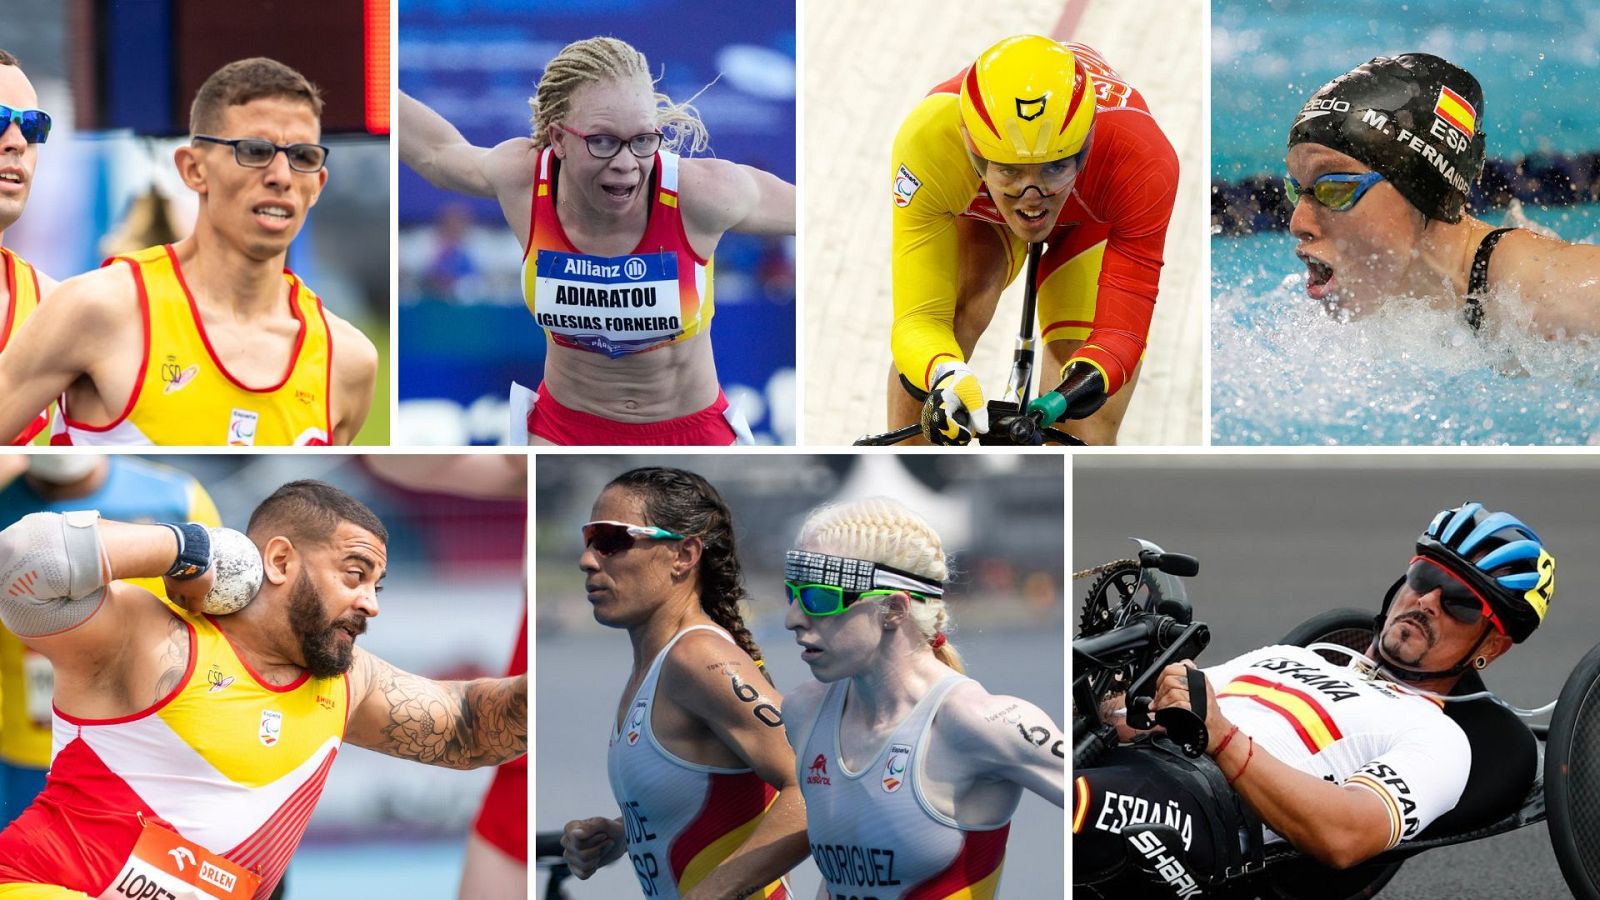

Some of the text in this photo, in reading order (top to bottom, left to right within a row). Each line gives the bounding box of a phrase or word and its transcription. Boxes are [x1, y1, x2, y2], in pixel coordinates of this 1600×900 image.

[1361, 108, 1390, 135] M.
[1430, 117, 1468, 155] ESP
[900, 167, 918, 186] España
[563, 257, 621, 278] Allianz
[555, 285, 657, 308] ADIARATOU
[537, 312, 679, 332] IGLESIAS FORNEIRO
[162, 363, 182, 384] CSD
[731, 676, 785, 728] 60
[1095, 790, 1193, 852] ESPAÑA
[632, 852, 659, 897] SP
[1127, 830, 1203, 900] SHARK
